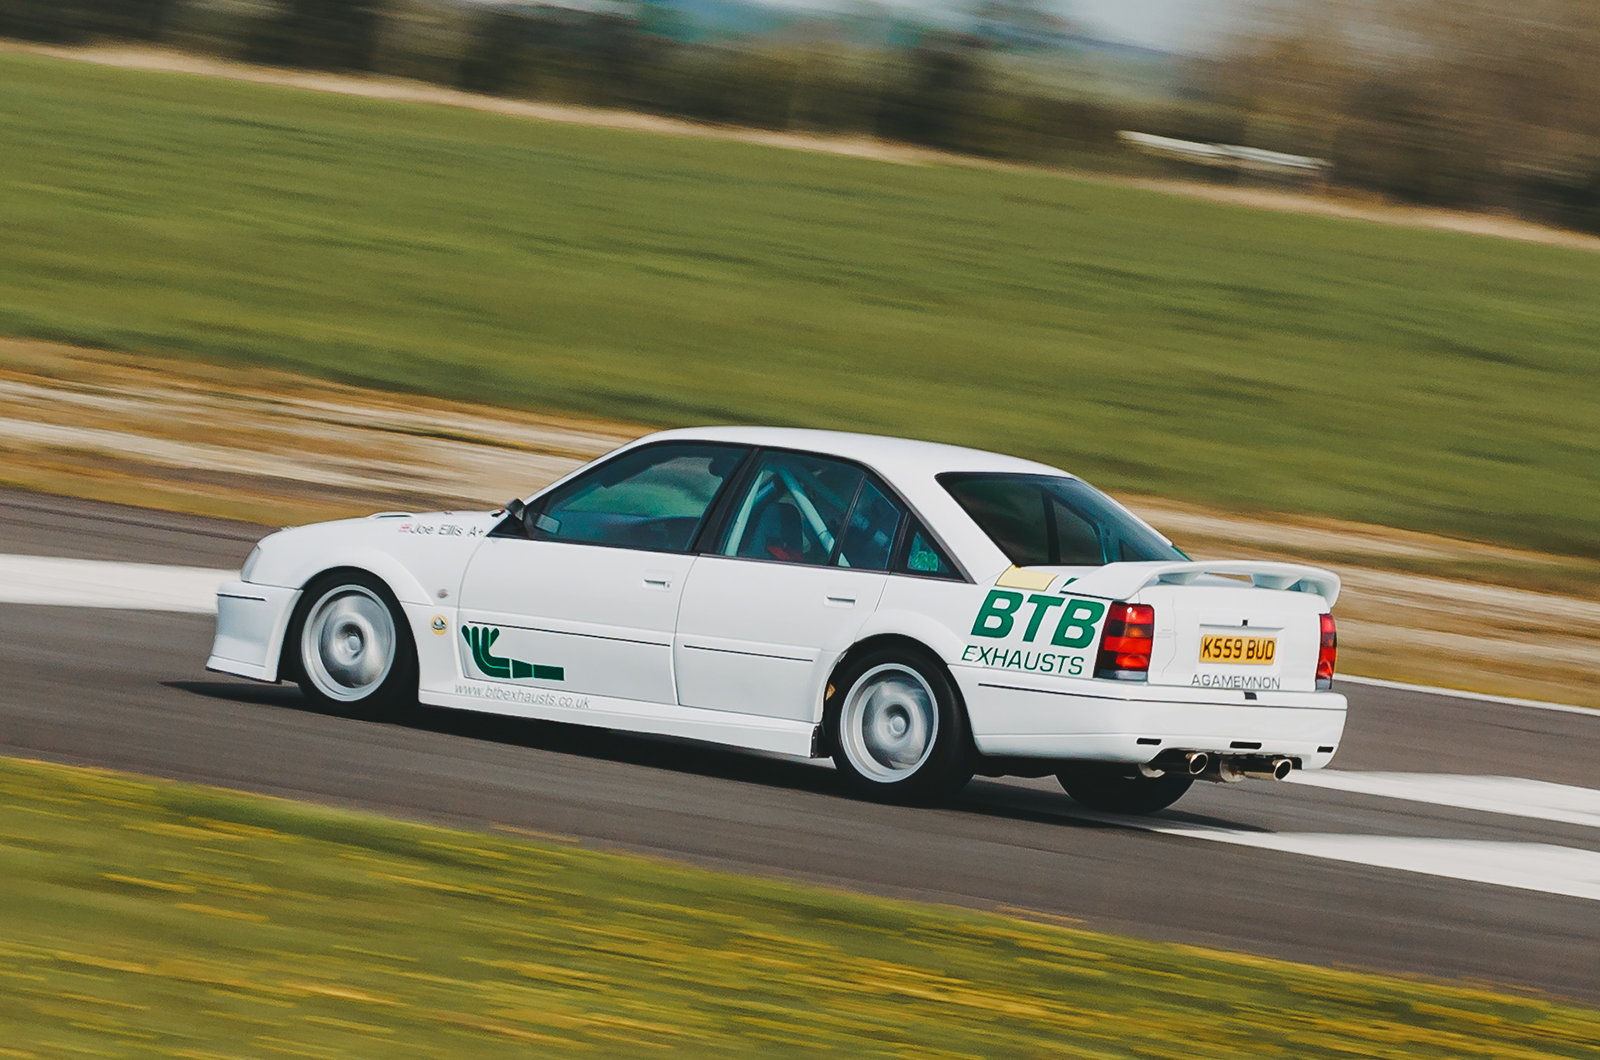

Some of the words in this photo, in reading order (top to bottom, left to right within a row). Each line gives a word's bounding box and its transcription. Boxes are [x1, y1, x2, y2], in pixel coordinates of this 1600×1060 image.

[410, 523, 434, 535] Joe
[970, 589, 1105, 649] BTB
[961, 644, 1085, 676] EXHAUSTS
[1202, 637, 1243, 660] K559
[1246, 639, 1275, 661] BUD
[1191, 673, 1281, 690] AGAMEMNON
[454, 683, 591, 710] www.btbexhausts.co.uk
